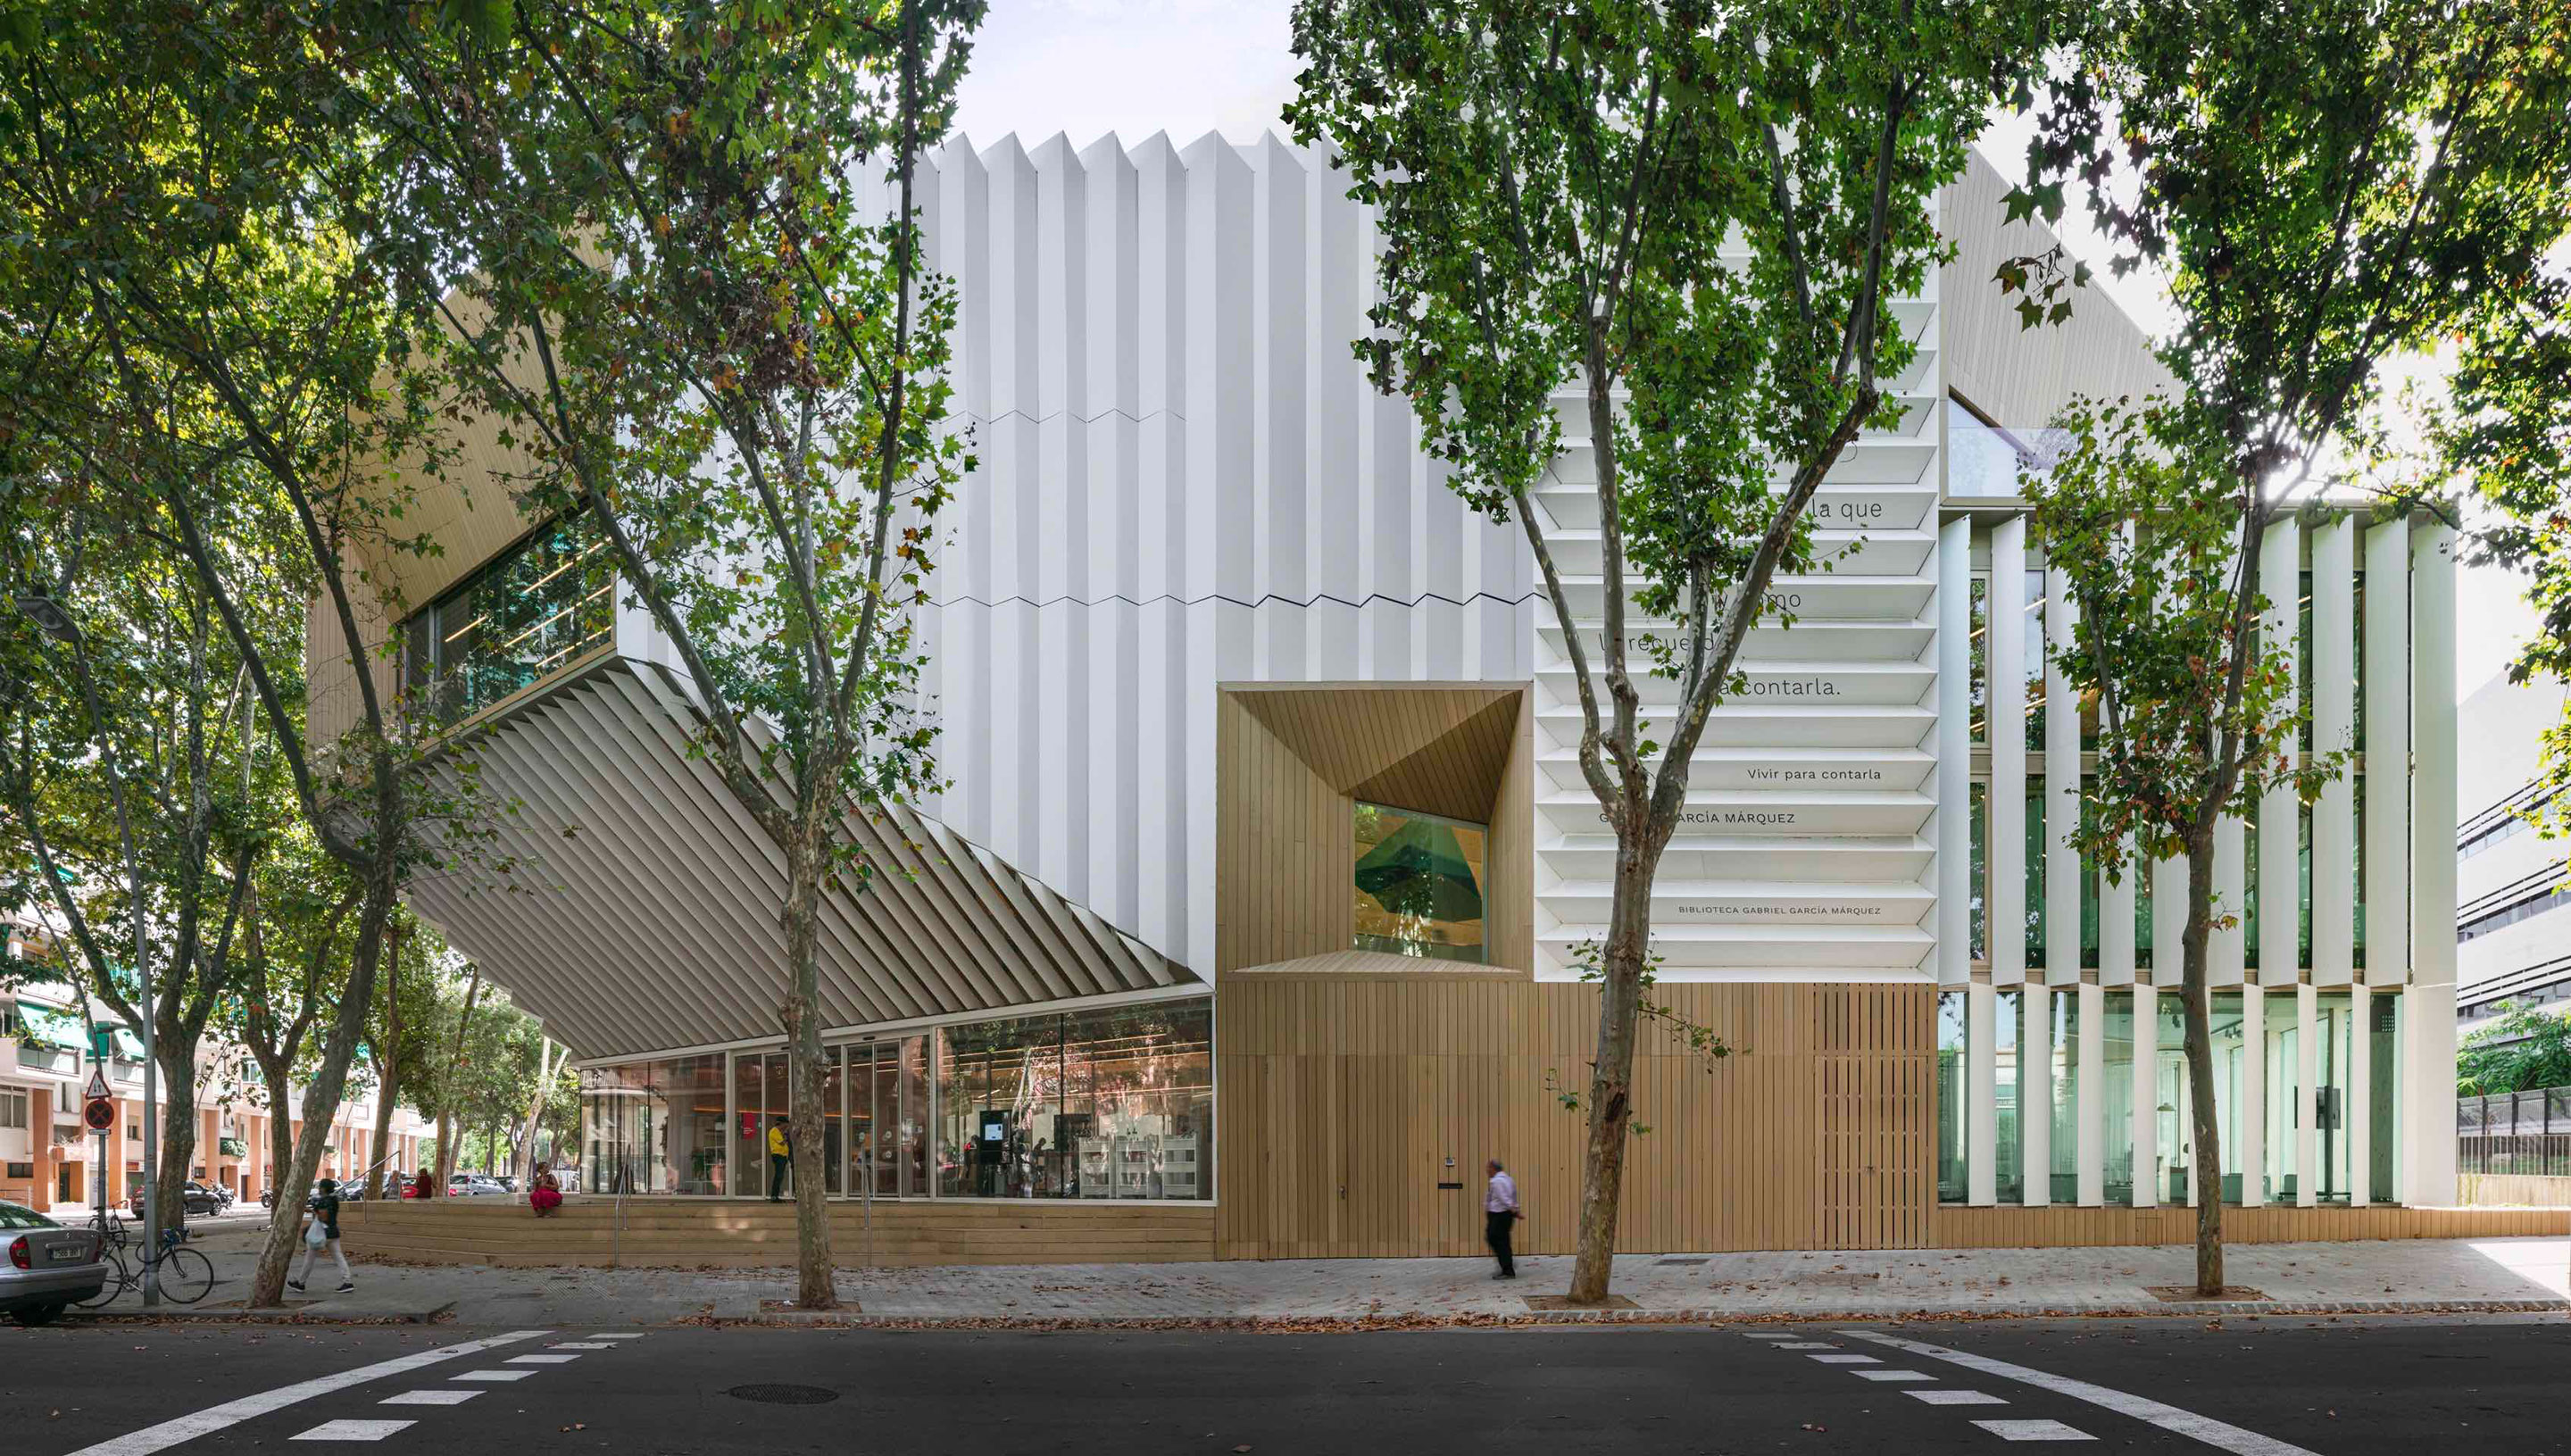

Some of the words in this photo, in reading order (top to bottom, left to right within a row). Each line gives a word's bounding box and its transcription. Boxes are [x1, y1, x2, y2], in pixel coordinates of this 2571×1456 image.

[1841, 502, 1882, 521] que
[1743, 677, 1842, 696] contarla.
[1747, 768, 1779, 780] Vivir
[1785, 770, 1816, 782] para
[1821, 768, 1881, 780] contarla
[1677, 809, 1720, 823] ARCÍA
[1725, 810, 1795, 826] MÁRQUEZ
[1678, 905, 1740, 914] BIBLIOTECA
[1742, 906, 1786, 915] GABRIEL
[1789, 905, 1827, 915] GARCÍA
[1831, 905, 1881, 917] MÁRQUEZ
